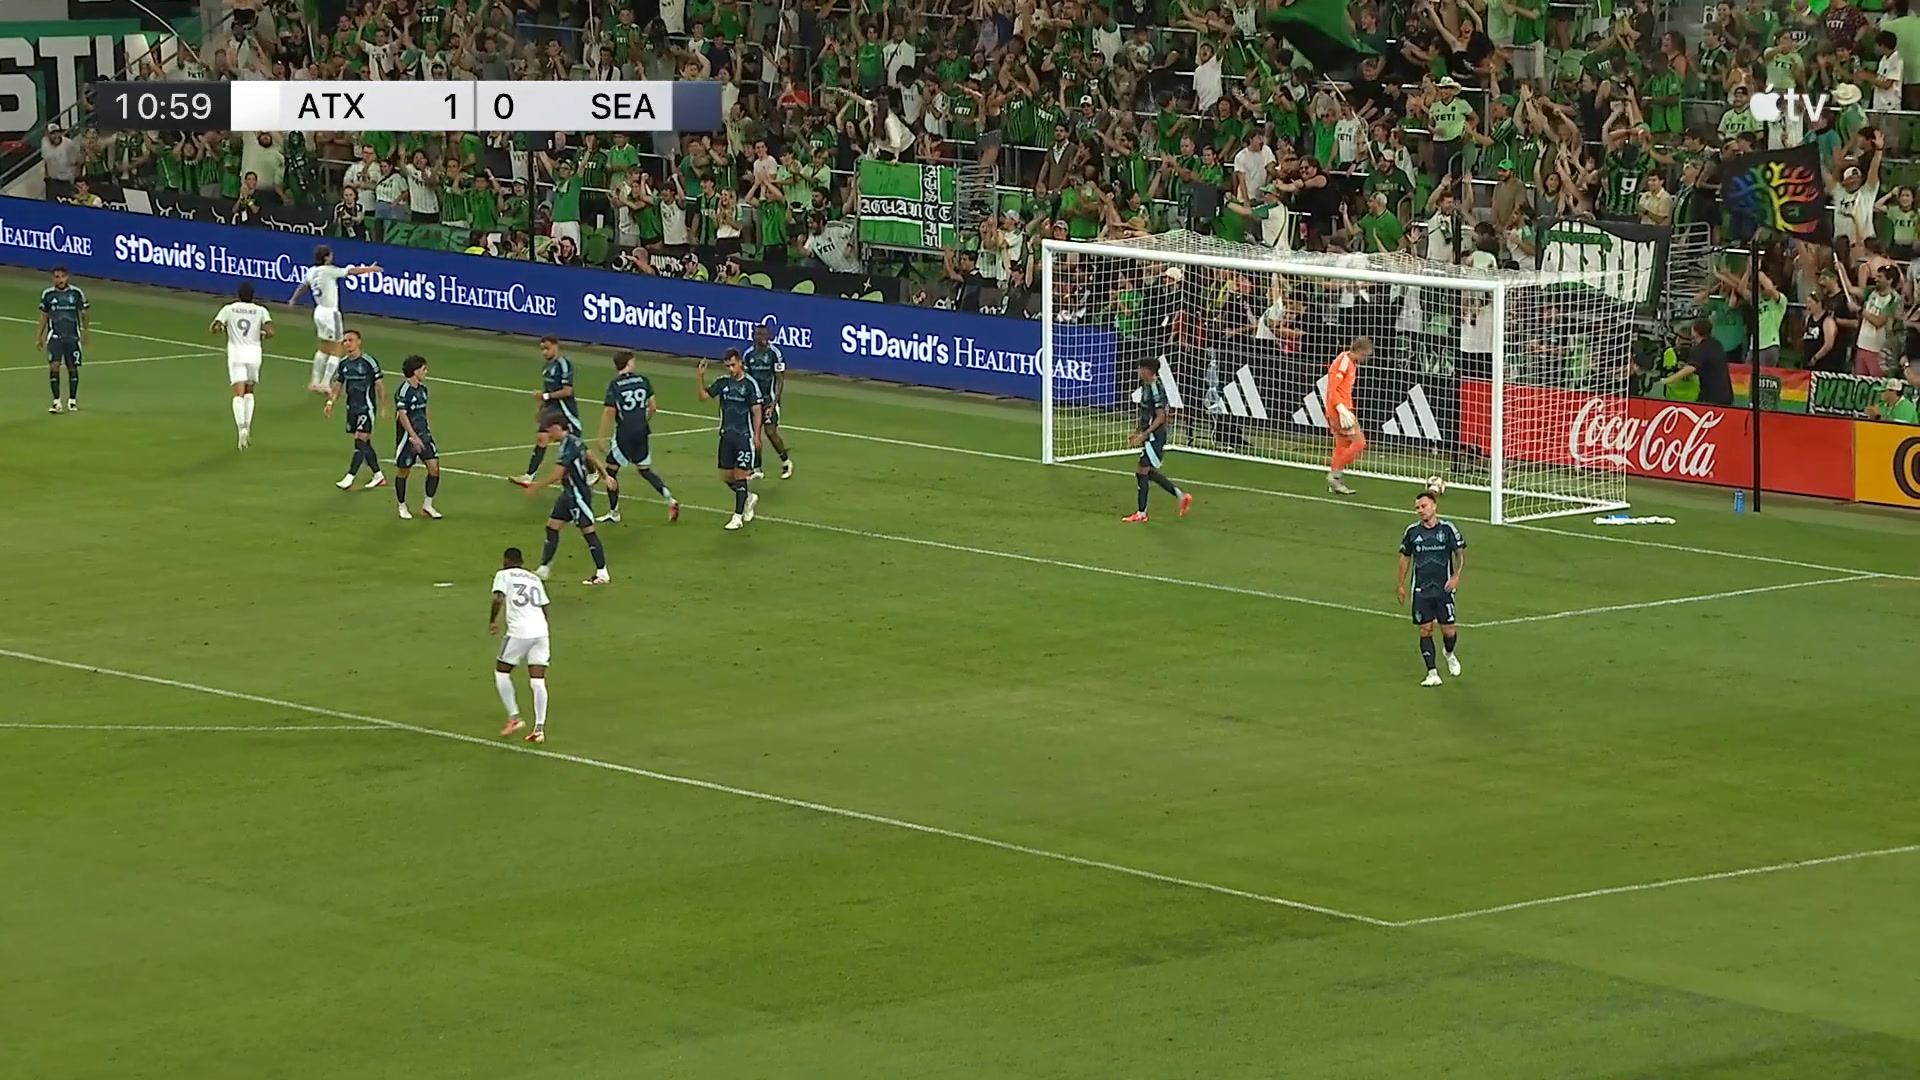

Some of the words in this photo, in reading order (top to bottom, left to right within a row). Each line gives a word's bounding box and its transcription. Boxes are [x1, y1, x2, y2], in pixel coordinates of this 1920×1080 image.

[1826, 20, 1844, 29] YETI
[954, 107, 970, 115] YETI
[1037, 108, 1053, 122] YETI
[1434, 113, 1455, 121] YETI
[1726, 123, 1745, 131] YETI
[1621, 177, 1637, 195] 9
[861, 199, 952, 221] AGUANTE
[818, 244, 836, 254] YETI
[237, 318, 251, 337] 9
[73, 351, 81, 364] 9
[620, 388, 647, 411] 39
[1569, 398, 1725, 478] Coca-Cola
[736, 451, 751, 463] 25
[512, 583, 542, 607] 30
